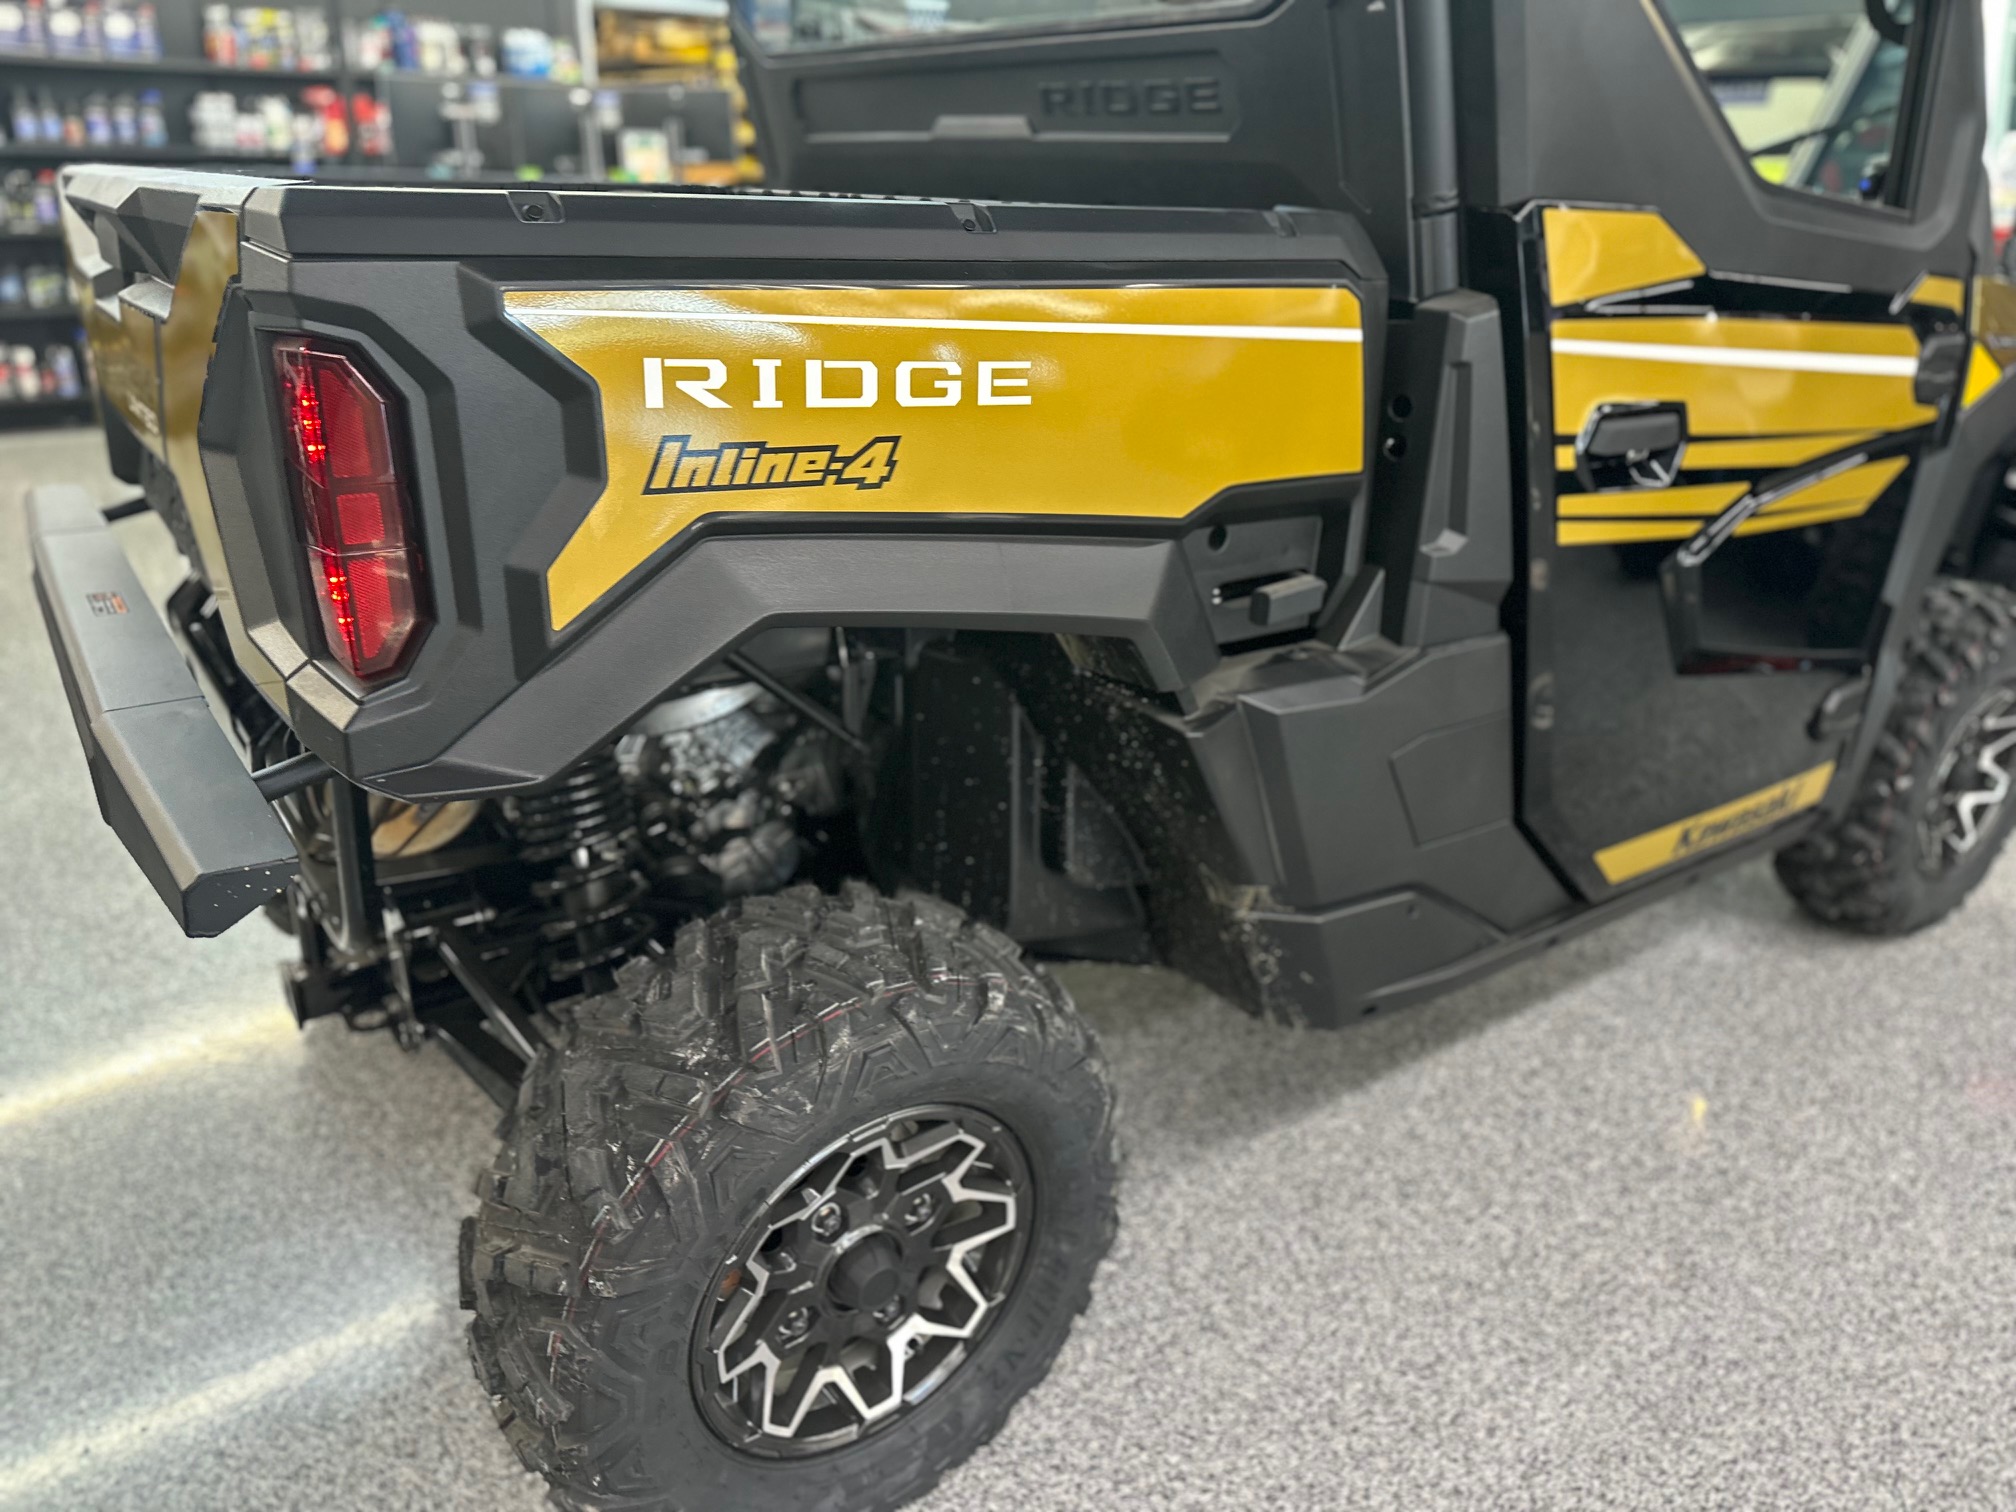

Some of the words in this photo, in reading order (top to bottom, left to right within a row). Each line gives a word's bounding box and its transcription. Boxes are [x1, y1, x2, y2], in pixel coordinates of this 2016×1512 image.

[1039, 78, 1222, 117] RIDGE
[643, 357, 1032, 409] RIDGE
[641, 434, 901, 496] Inline-4
